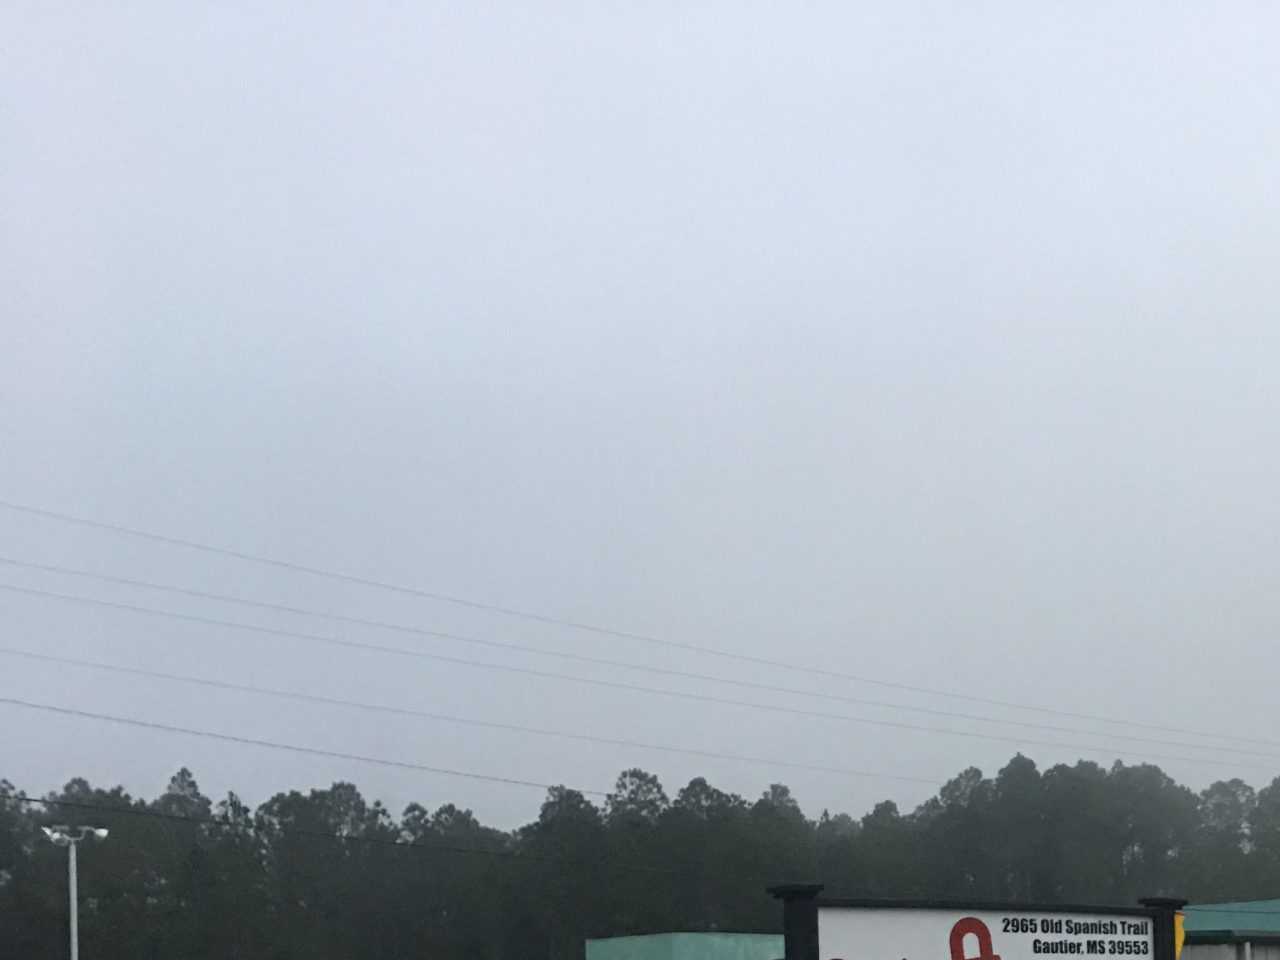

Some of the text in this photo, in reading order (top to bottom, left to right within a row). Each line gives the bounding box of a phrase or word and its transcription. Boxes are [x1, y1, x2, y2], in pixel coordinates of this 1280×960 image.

[1002, 918, 1149, 936] 2965 Old Spanish Trail
[1032, 939, 1149, 955] Gautier, MS 39553
